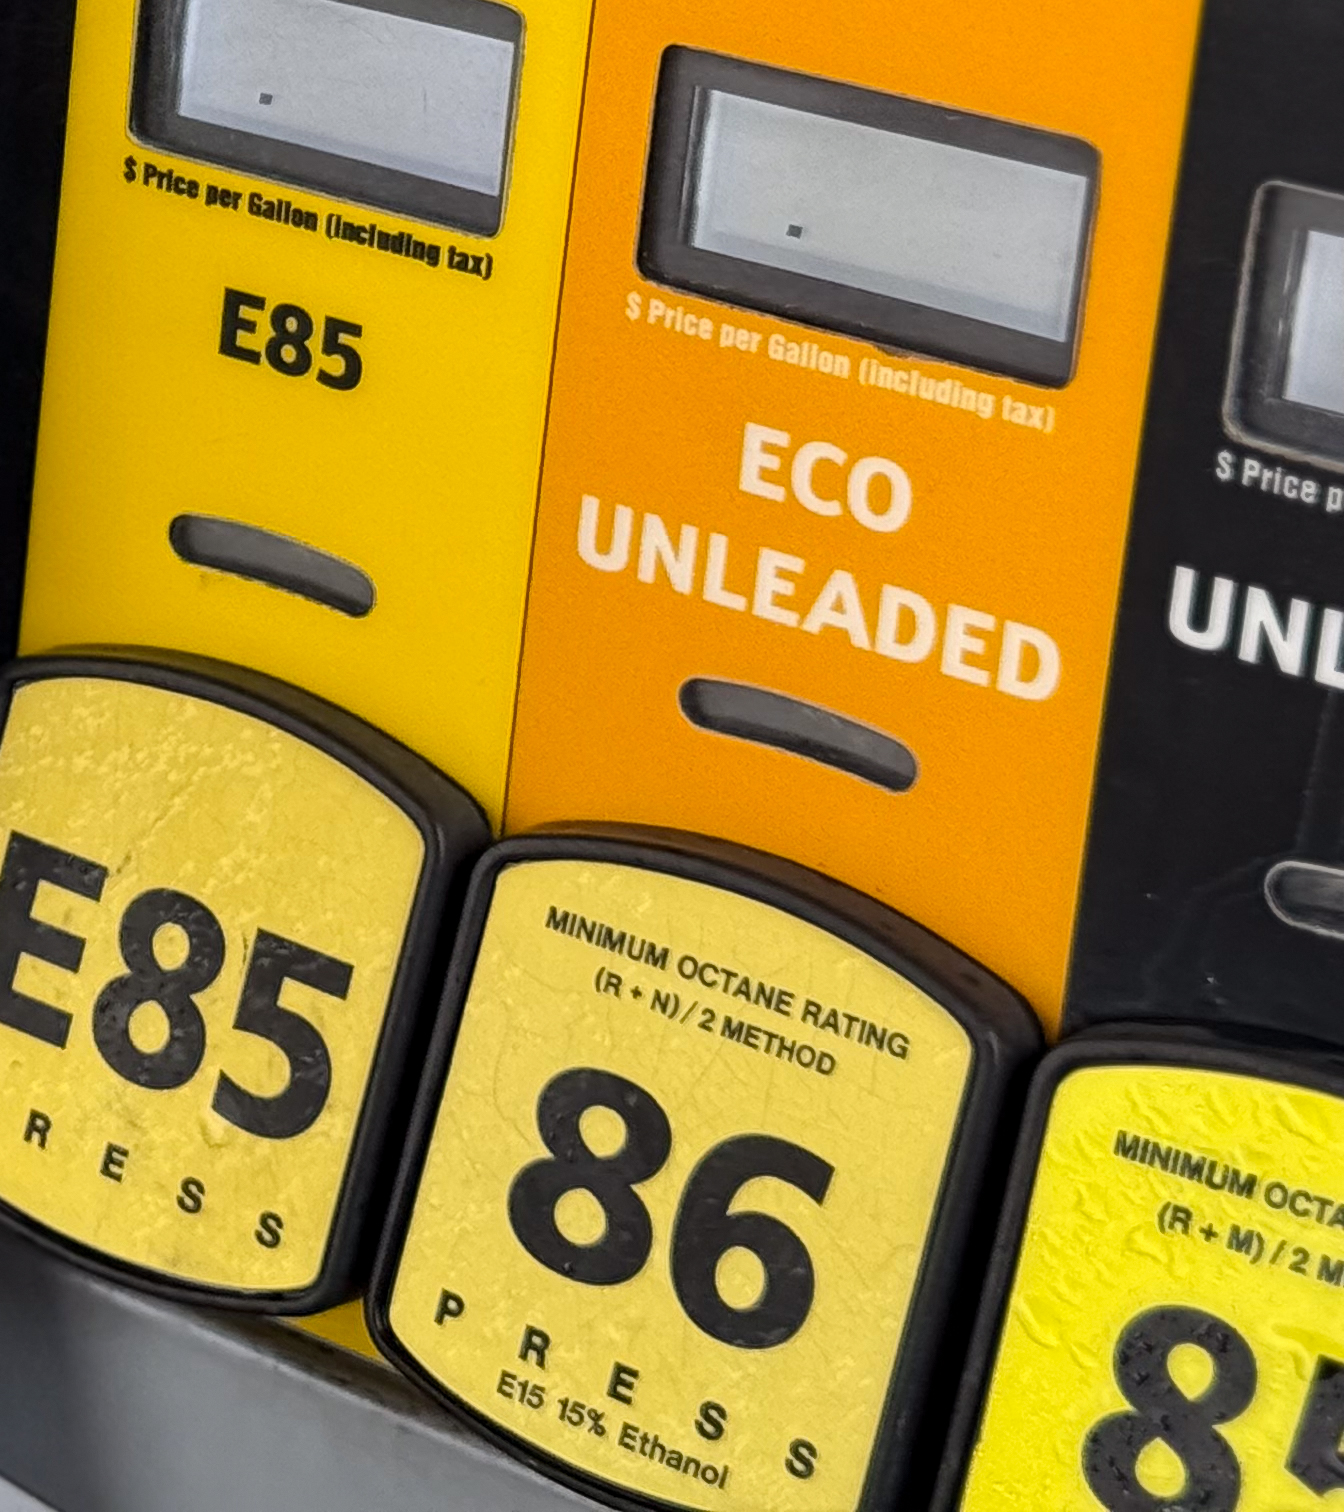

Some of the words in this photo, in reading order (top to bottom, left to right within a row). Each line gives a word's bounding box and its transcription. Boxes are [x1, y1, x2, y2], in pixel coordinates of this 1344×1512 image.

[123, 155, 138, 184] $
[143, 162, 200, 199] Price
[205, 184, 242, 212] per
[247, 191, 318, 232] Gallon
[325, 212, 441, 269] (including
[446, 246, 494, 281] tax)
[217, 286, 363, 391] E85
[625, 291, 642, 323] $
[648, 300, 712, 340] Price
[719, 323, 761, 355] per
[768, 333, 849, 380] Gallon
[858, 357, 996, 419] (including
[1001, 393, 1057, 434] tax)
[739, 420, 913, 534] ECO
[1215, 450, 1235, 482] $
[1241, 458, 1317, 504] Price
[576, 493, 1062, 703] UNLEADED
[545, 905, 670, 972] MINIMUM
[677, 954, 795, 1017] OCTANE
[800, 998, 911, 1060] RATING
[630, 984, 643, 1000] +
[720, 1014, 837, 1076] METHOD
[507, 1067, 836, 1350] 86
[1113, 1129, 1258, 1200] MINIMUM
[1157, 1201, 1193, 1236] (R
[1199, 1223, 1218, 1242] +
[1226, 1224, 1264, 1265] M)
[1269, 1239, 1287, 1265] /
[1288, 1246, 1310, 1275] 2
[496, 1371, 546, 1409] E15
[557, 1396, 607, 1437] 15%
[617, 1422, 729, 1489] Ethanol
